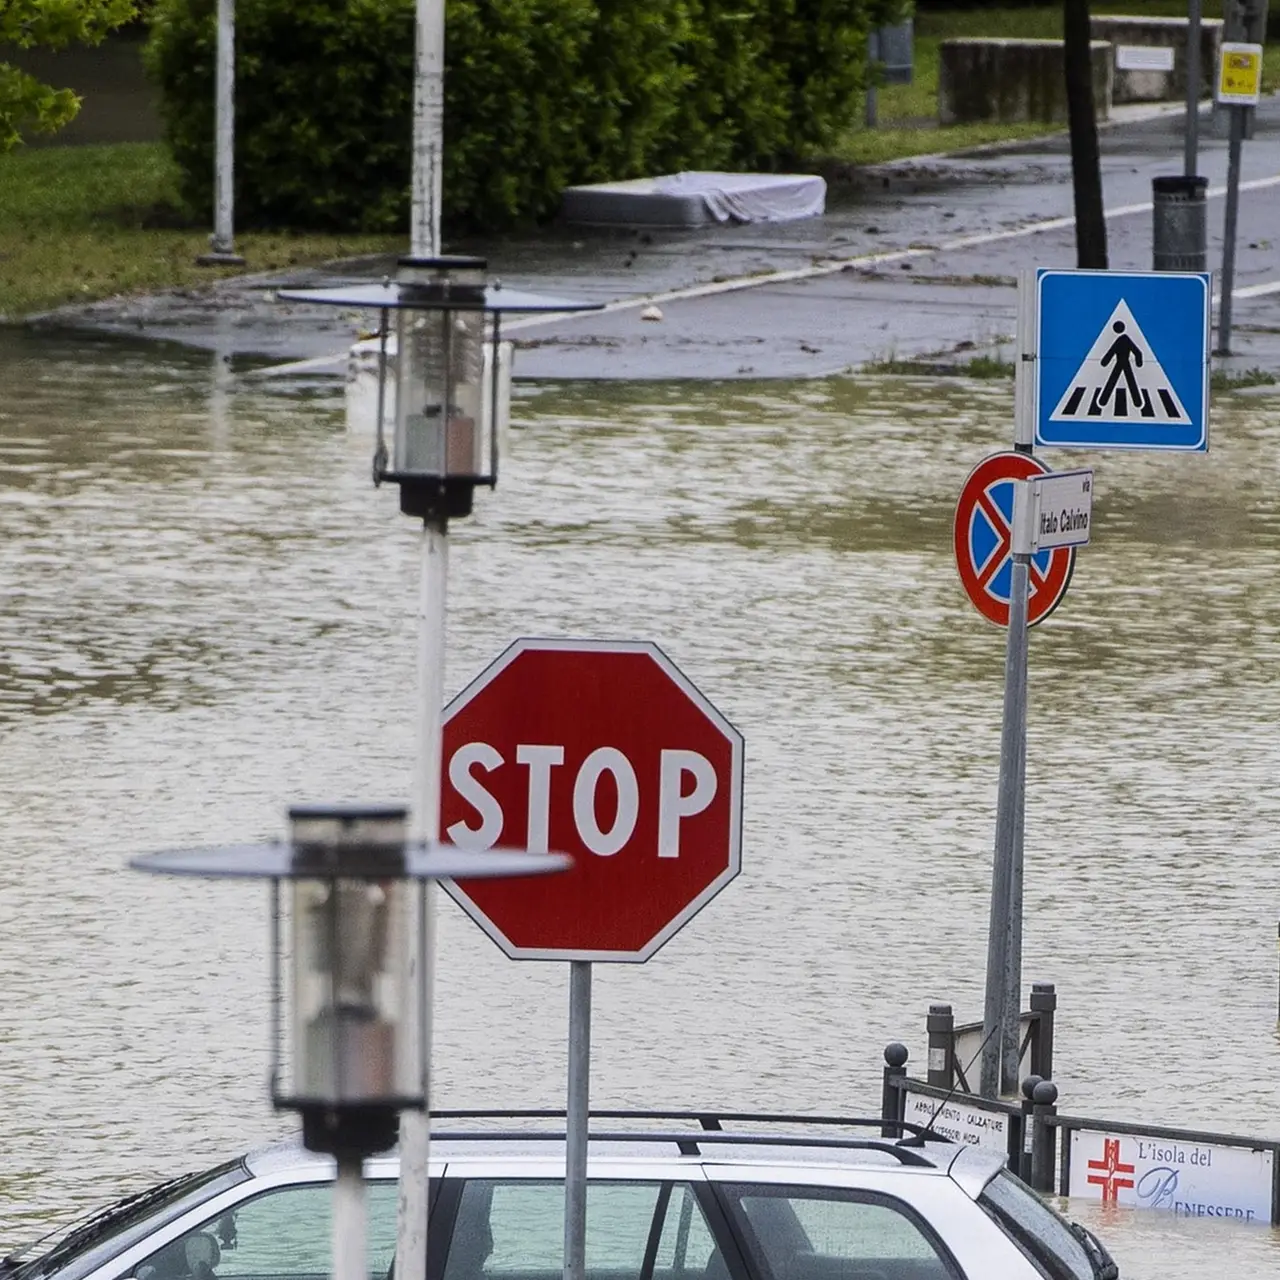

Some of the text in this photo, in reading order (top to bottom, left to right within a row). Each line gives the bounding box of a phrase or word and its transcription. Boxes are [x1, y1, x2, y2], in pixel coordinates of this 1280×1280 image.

[1082, 476, 1090, 492] via
[1039, 507, 1089, 535] Italo Calvino
[447, 742, 718, 858] STOP
[967, 1114, 1004, 1132] CALZATURE
[963, 1131, 981, 1146] MODA
[1138, 1142, 1212, 1167] L'isola del
